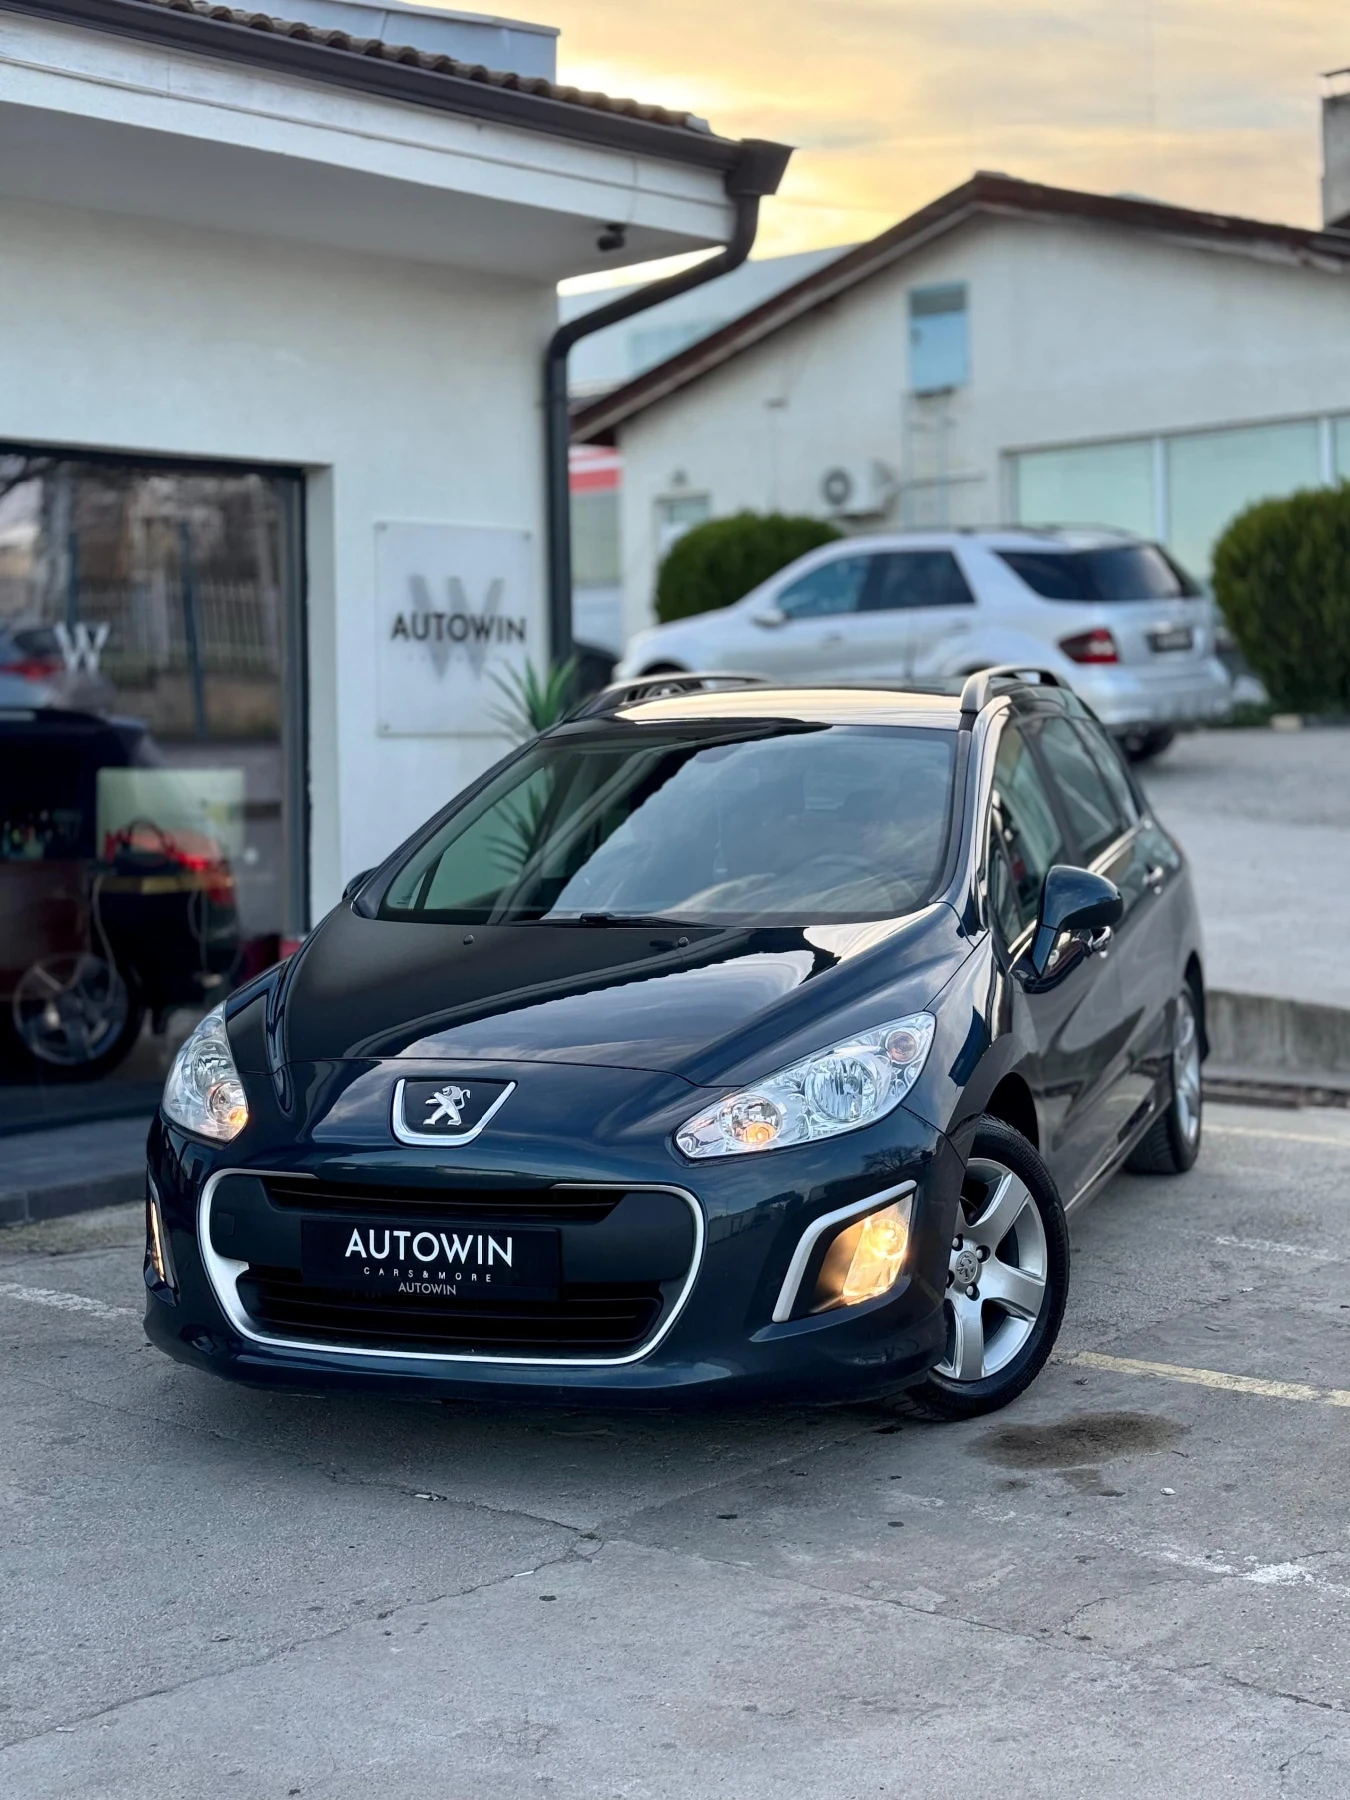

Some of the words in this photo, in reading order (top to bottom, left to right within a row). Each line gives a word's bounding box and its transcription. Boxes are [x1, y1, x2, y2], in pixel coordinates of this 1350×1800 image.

[390, 612, 527, 643] AUTOWIN
[345, 1229, 512, 1267] AUTOWIN
[398, 1282, 456, 1295] AUTOWIN
